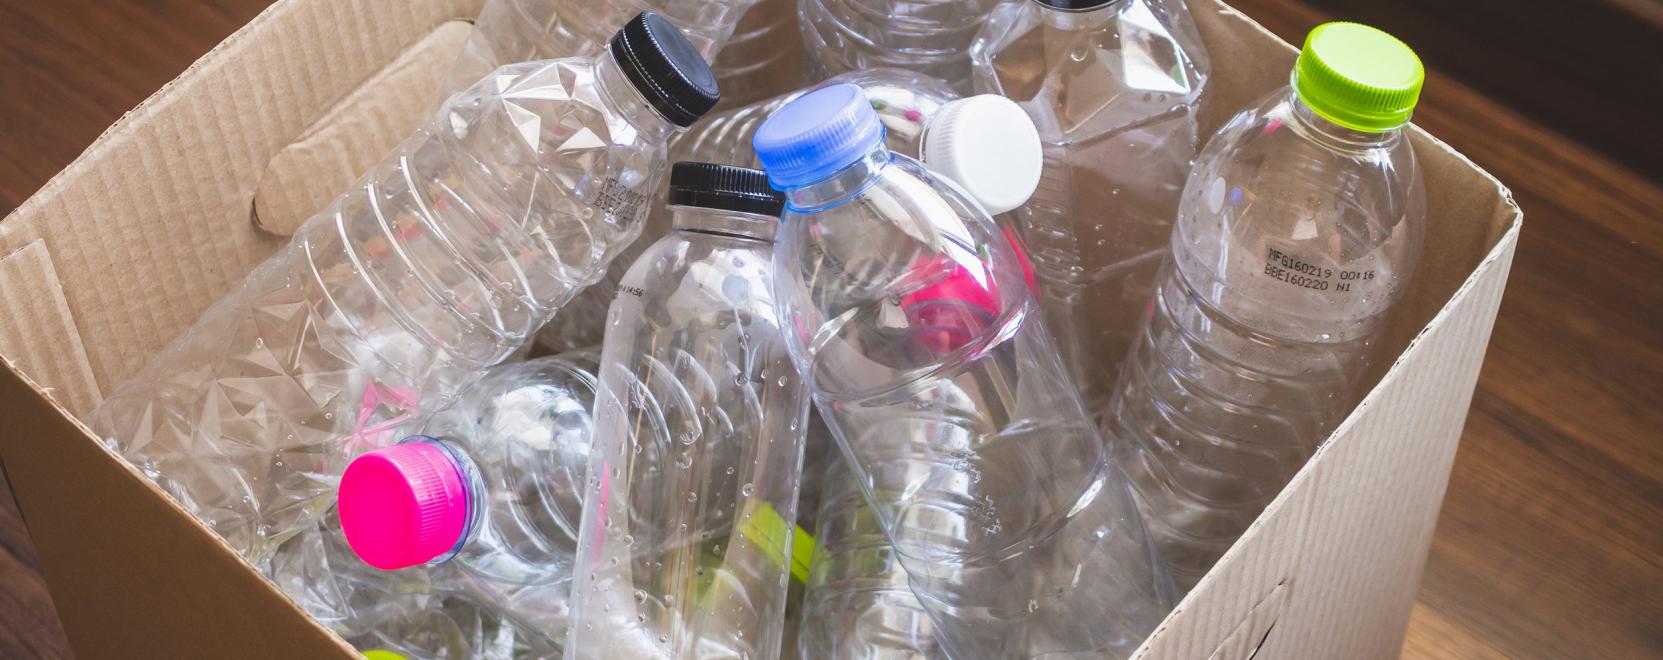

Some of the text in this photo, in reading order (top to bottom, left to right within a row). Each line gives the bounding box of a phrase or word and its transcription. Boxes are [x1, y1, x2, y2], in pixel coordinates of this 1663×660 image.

[1264, 263, 1328, 291] BBE160220
[1268, 248, 1375, 280] MFG160219 00:16
